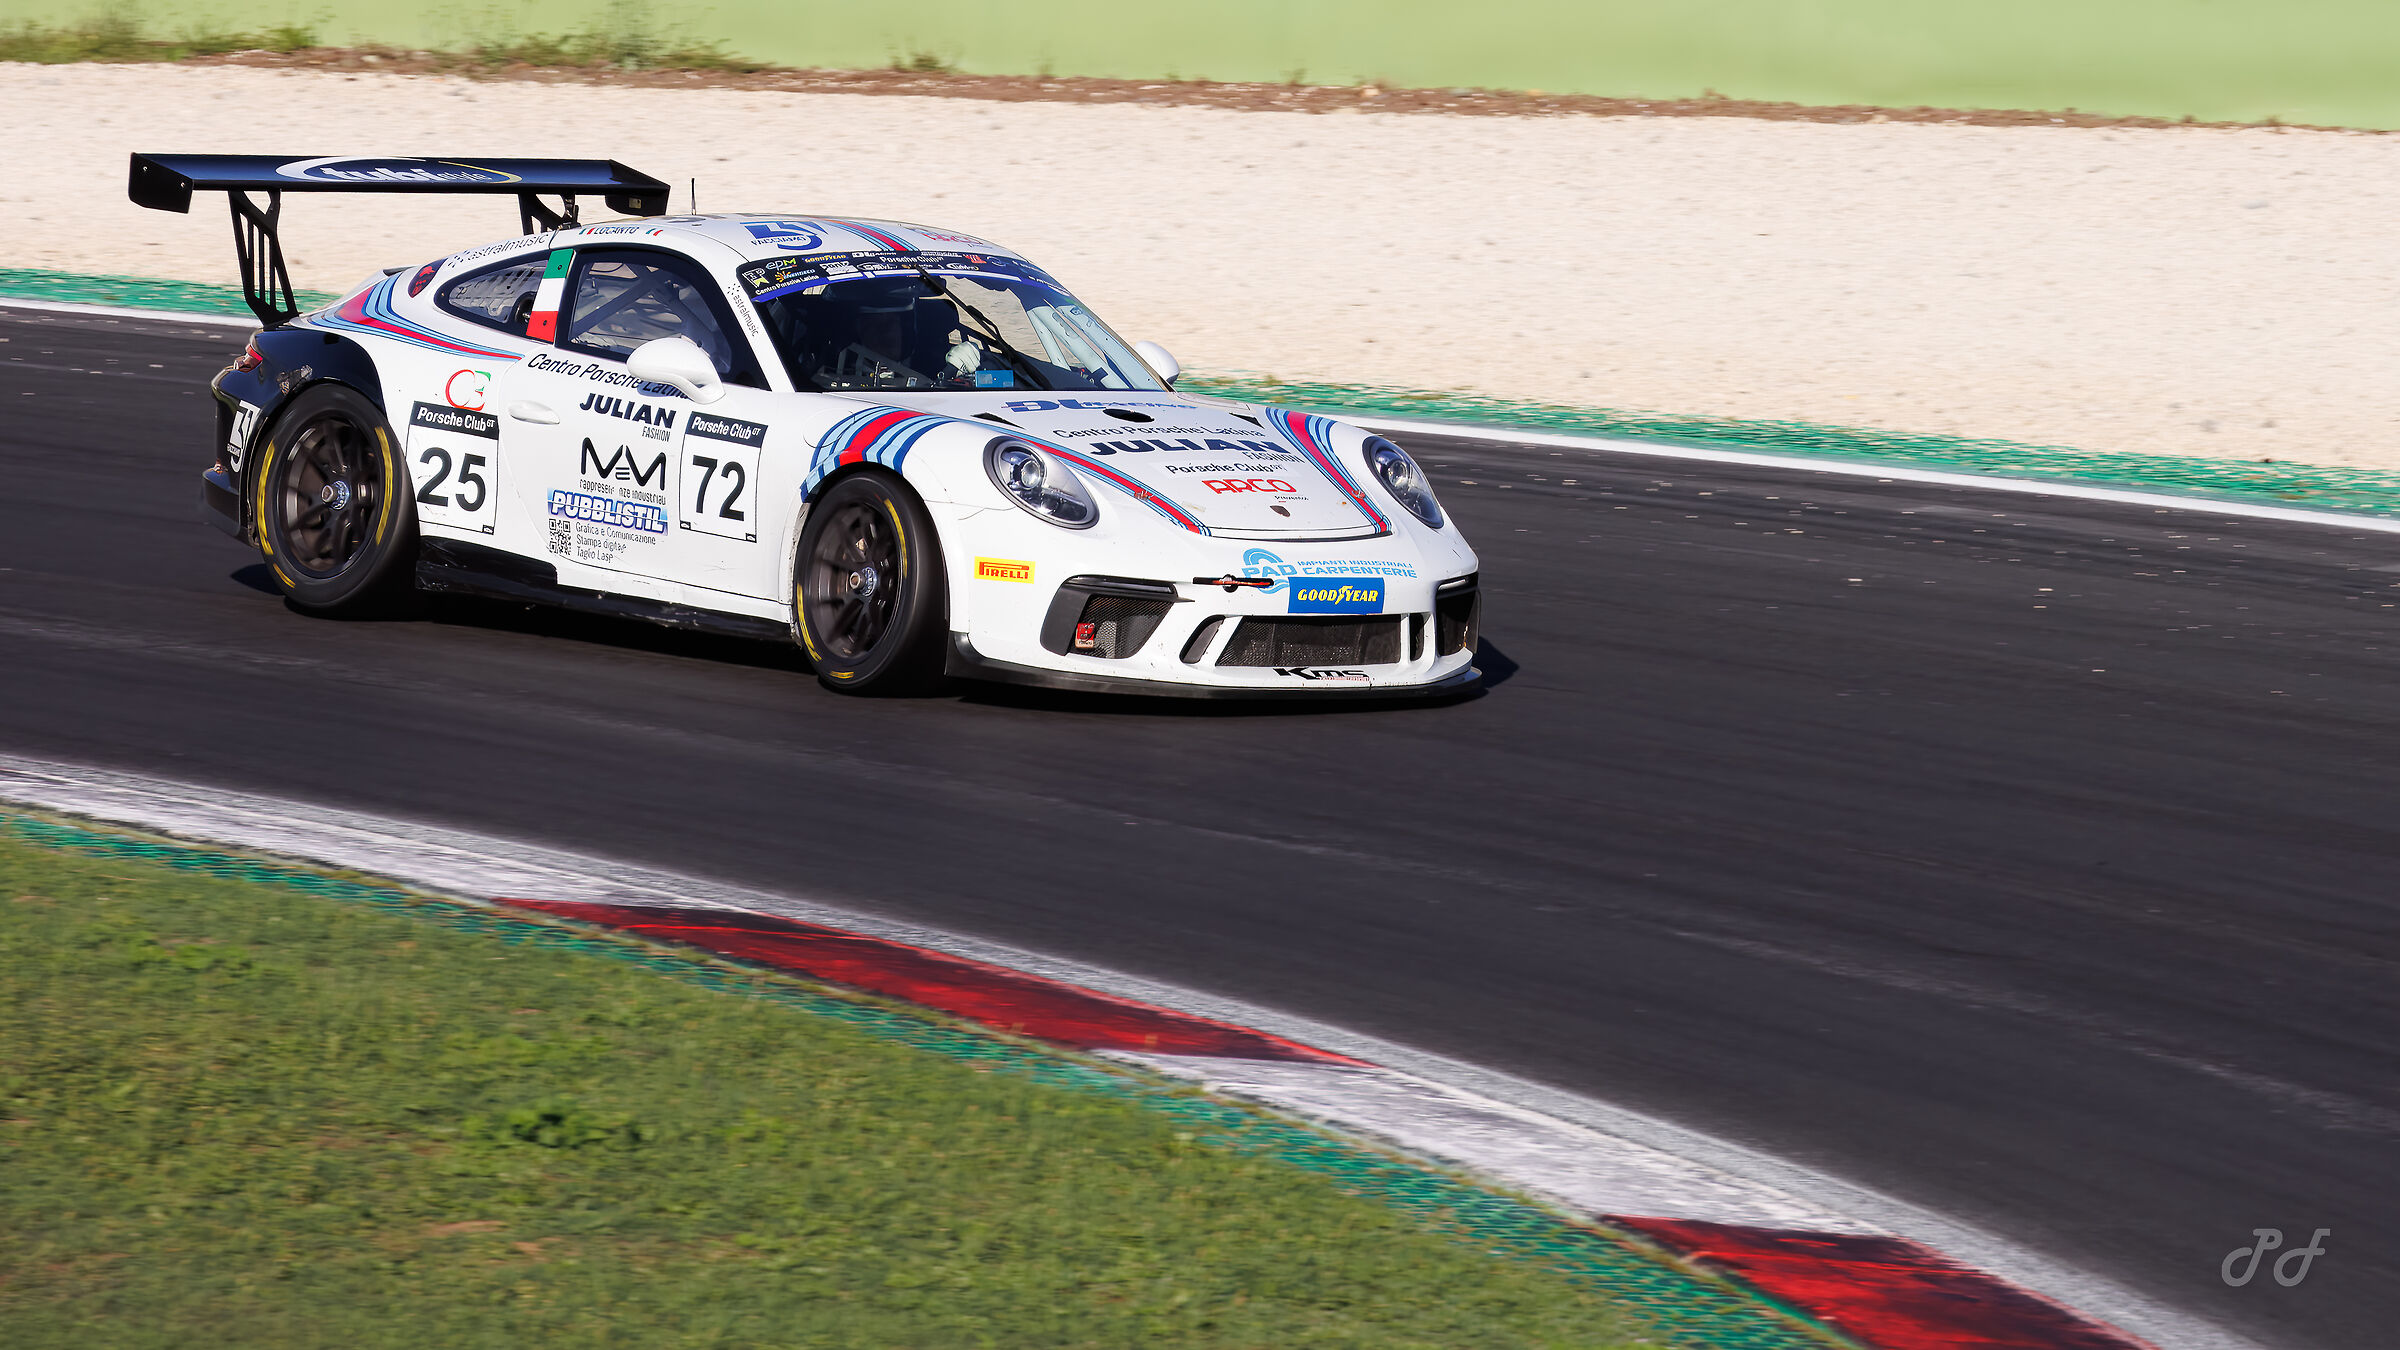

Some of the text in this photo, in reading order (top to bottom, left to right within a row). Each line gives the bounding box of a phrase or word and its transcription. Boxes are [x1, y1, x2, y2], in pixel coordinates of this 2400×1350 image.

[467, 234, 549, 261] astralmusic
[733, 294, 759, 337] astralmusic
[527, 353, 582, 376] Centro
[416, 406, 463, 427] Porsche
[464, 414, 486, 432] Club
[579, 392, 677, 430] JULIAN
[641, 425, 671, 443] FASHION
[691, 415, 729, 436] Porsche
[730, 422, 751, 440] Club
[1052, 425, 1266, 438] Centro Porsche Latina
[1088, 438, 1292, 456] JULIAN
[1241, 451, 1306, 464] FASHION
[1165, 462, 1235, 475] Porsche
[1233, 462, 1273, 473] Club
[416, 446, 487, 512] 25
[691, 454, 747, 522] 72
[1201, 478, 1297, 494] ARCO
[550, 489, 667, 534] PUBBLISTIL
[575, 521, 656, 546] Grafica e Comunicazione
[576, 533, 601, 549] Stampa
[979, 561, 1030, 580] PIRELLI
[1241, 564, 1418, 579] PAD CARPENTERIE
[1349, 560, 1413, 569] INDUSTRIALI
[1297, 585, 1379, 605] GOODYEAR
[1272, 667, 1370, 681] Kms
